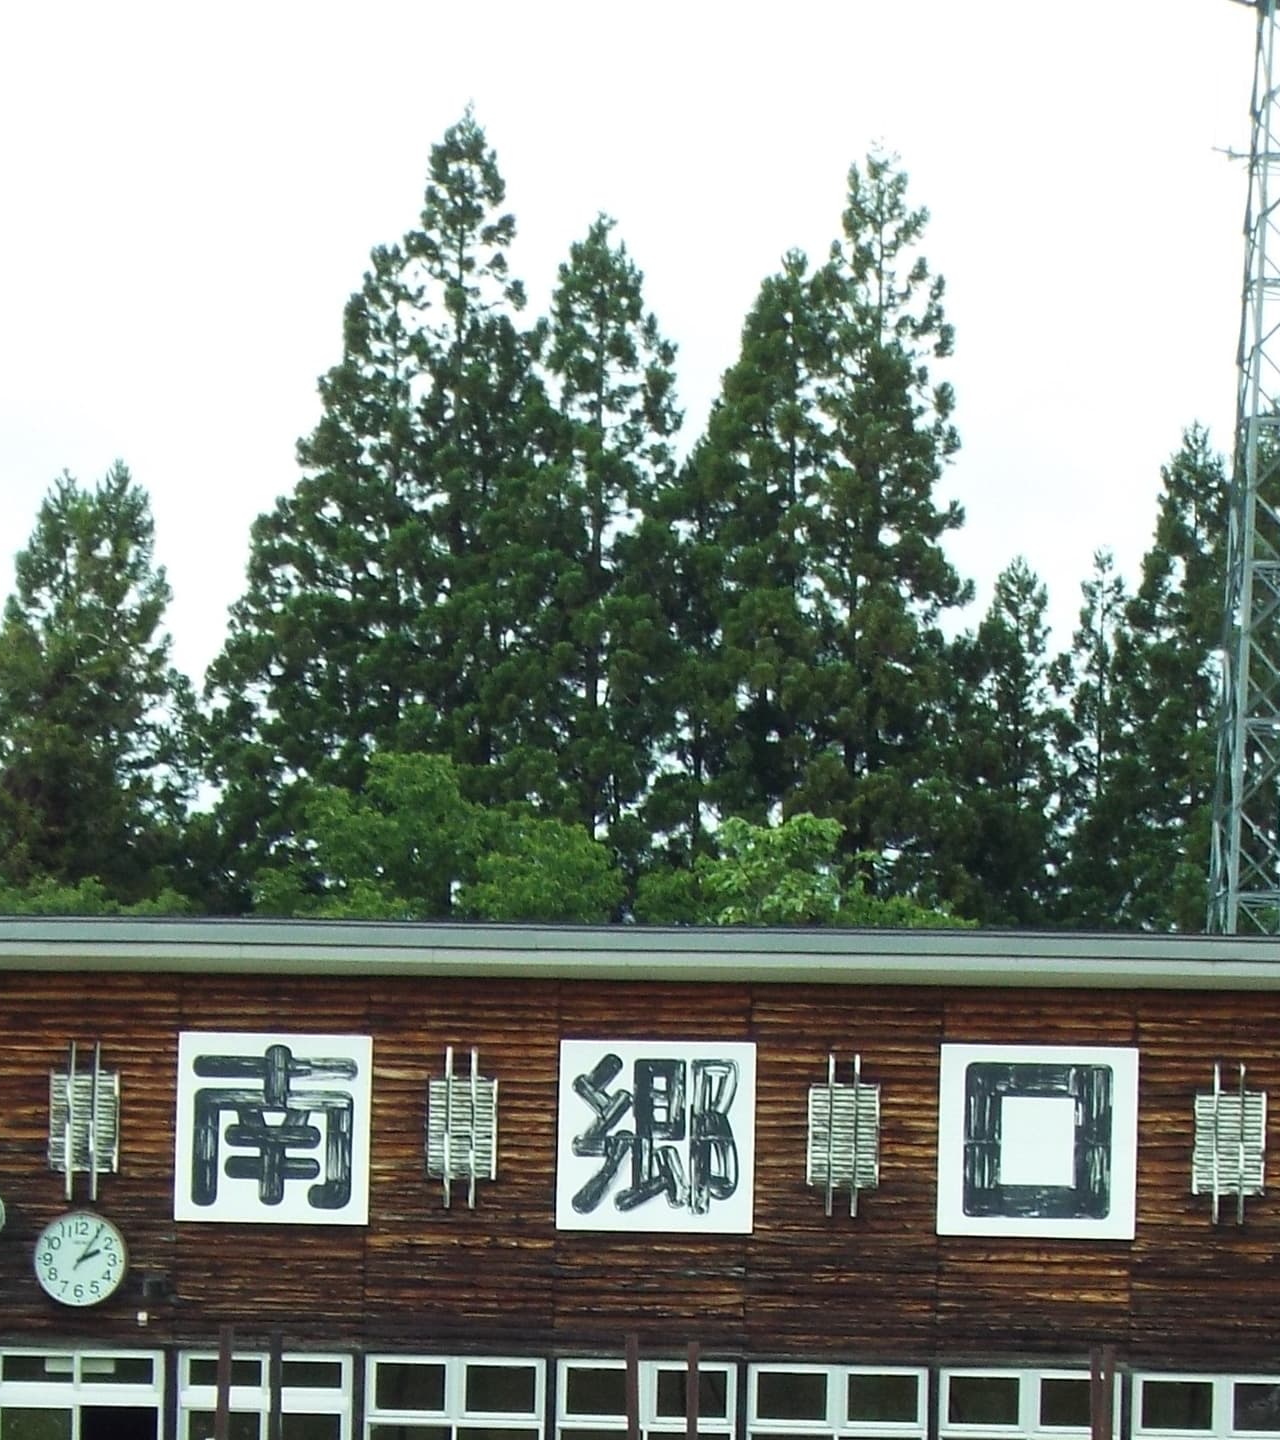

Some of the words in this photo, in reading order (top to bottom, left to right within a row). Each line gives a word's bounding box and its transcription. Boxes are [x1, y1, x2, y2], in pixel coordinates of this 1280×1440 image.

[60, 1221, 72, 1238] 11
[75, 1221, 89, 1235] 12
[45, 1235, 61, 1250] 10
[103, 1236, 113, 1250] 2
[42, 1252, 53, 1266] 9
[107, 1253, 117, 1267] 3
[48, 1267, 58, 1281] 8
[101, 1270, 111, 1281] 4
[60, 1280, 69, 1293] 7
[74, 1284, 84, 1297] 6
[90, 1280, 100, 1294] 5
